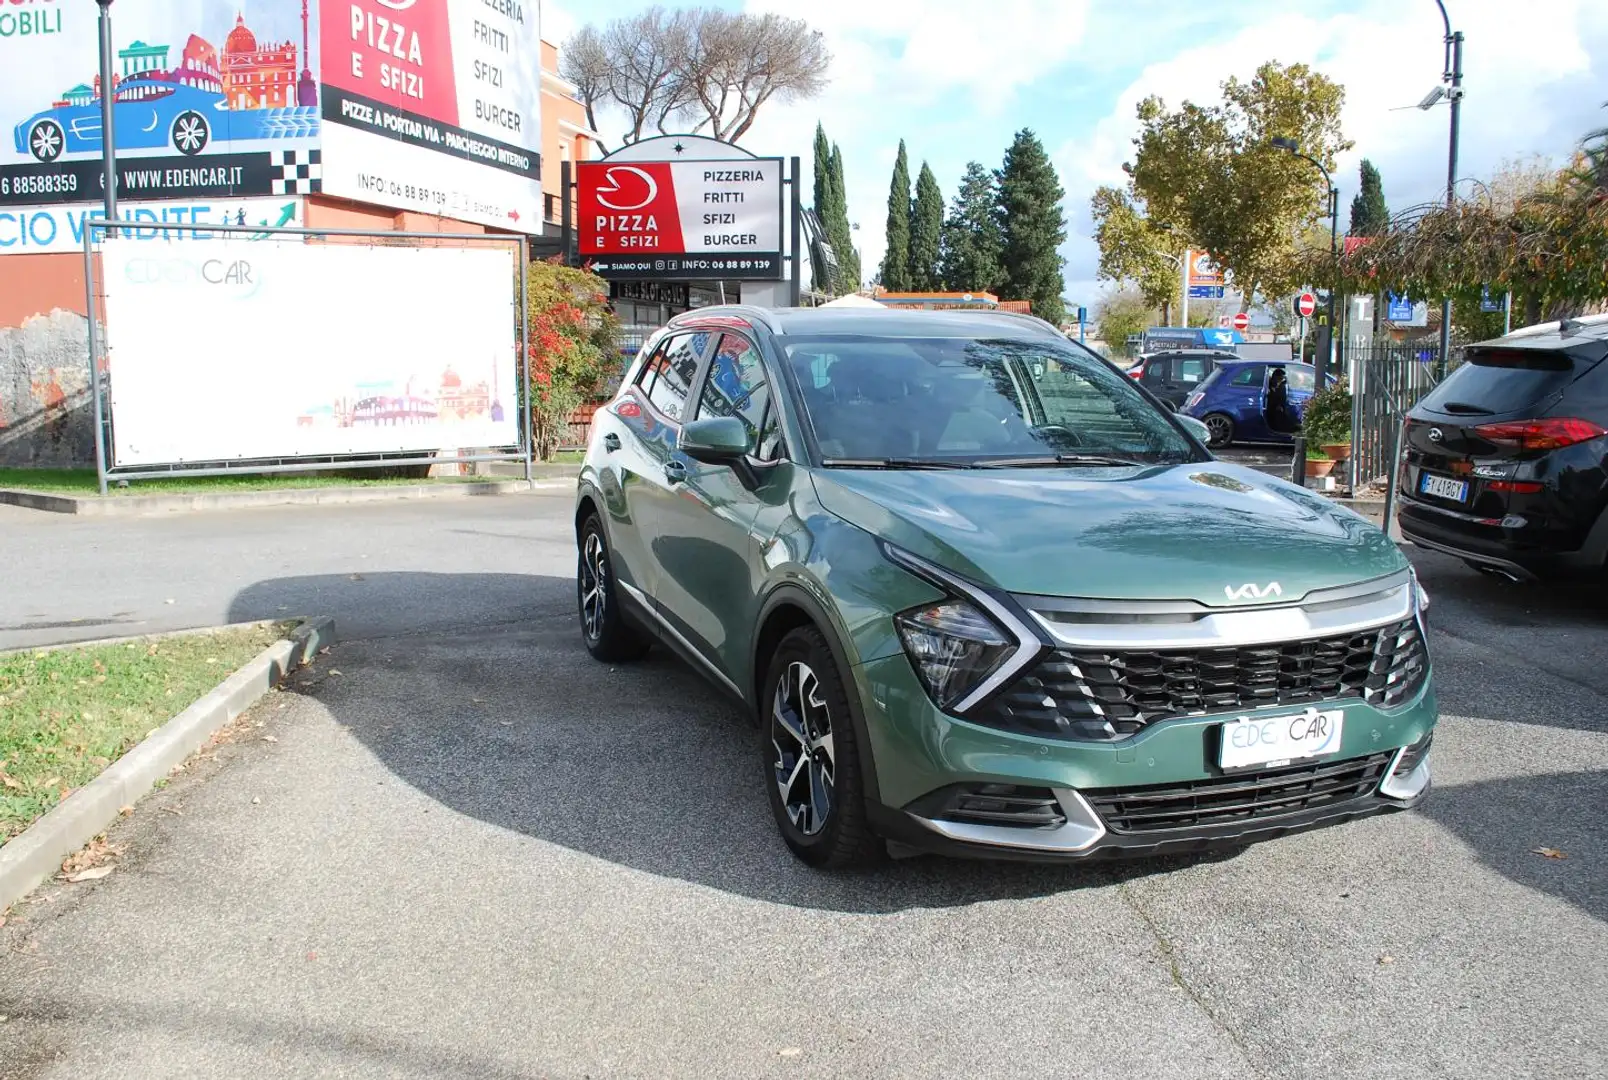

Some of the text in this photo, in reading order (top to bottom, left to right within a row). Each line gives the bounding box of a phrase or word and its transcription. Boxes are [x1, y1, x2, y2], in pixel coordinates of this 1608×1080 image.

[350, 5, 424, 67] PIZZA
[474, 20, 509, 55] FRITTI
[351, 51, 424, 100] E SFIZI
[474, 59, 504, 89] SFIZI
[475, 99, 521, 133] BURGER
[341, 99, 373, 124] PIZZE
[374, 109, 383, 127] A
[383, 111, 422, 138] PORTAR
[423, 124, 440, 144] VIA
[445, 132, 498, 160] PARCHEGGIO
[498, 148, 529, 171] INTERNO
[13, 174, 77, 195] 88588359
[125, 166, 243, 190] WWW.EDENCAR.IT
[703, 170, 764, 182] PIZZERIA
[357, 173, 388, 194] INFO:
[389, 182, 402, 197] 06
[405, 185, 416, 199] 88
[418, 188, 429, 202] 89
[432, 191, 446, 205] 139
[703, 192, 744, 204] FRITTI
[596, 215, 658, 232] PIZZA
[703, 213, 736, 225] SFIZI
[596, 235, 659, 248] E SFIZI
[703, 233, 757, 246] BURGER
[611, 260, 770, 271] SIAMO QUI INFO: 06 88 89 139
